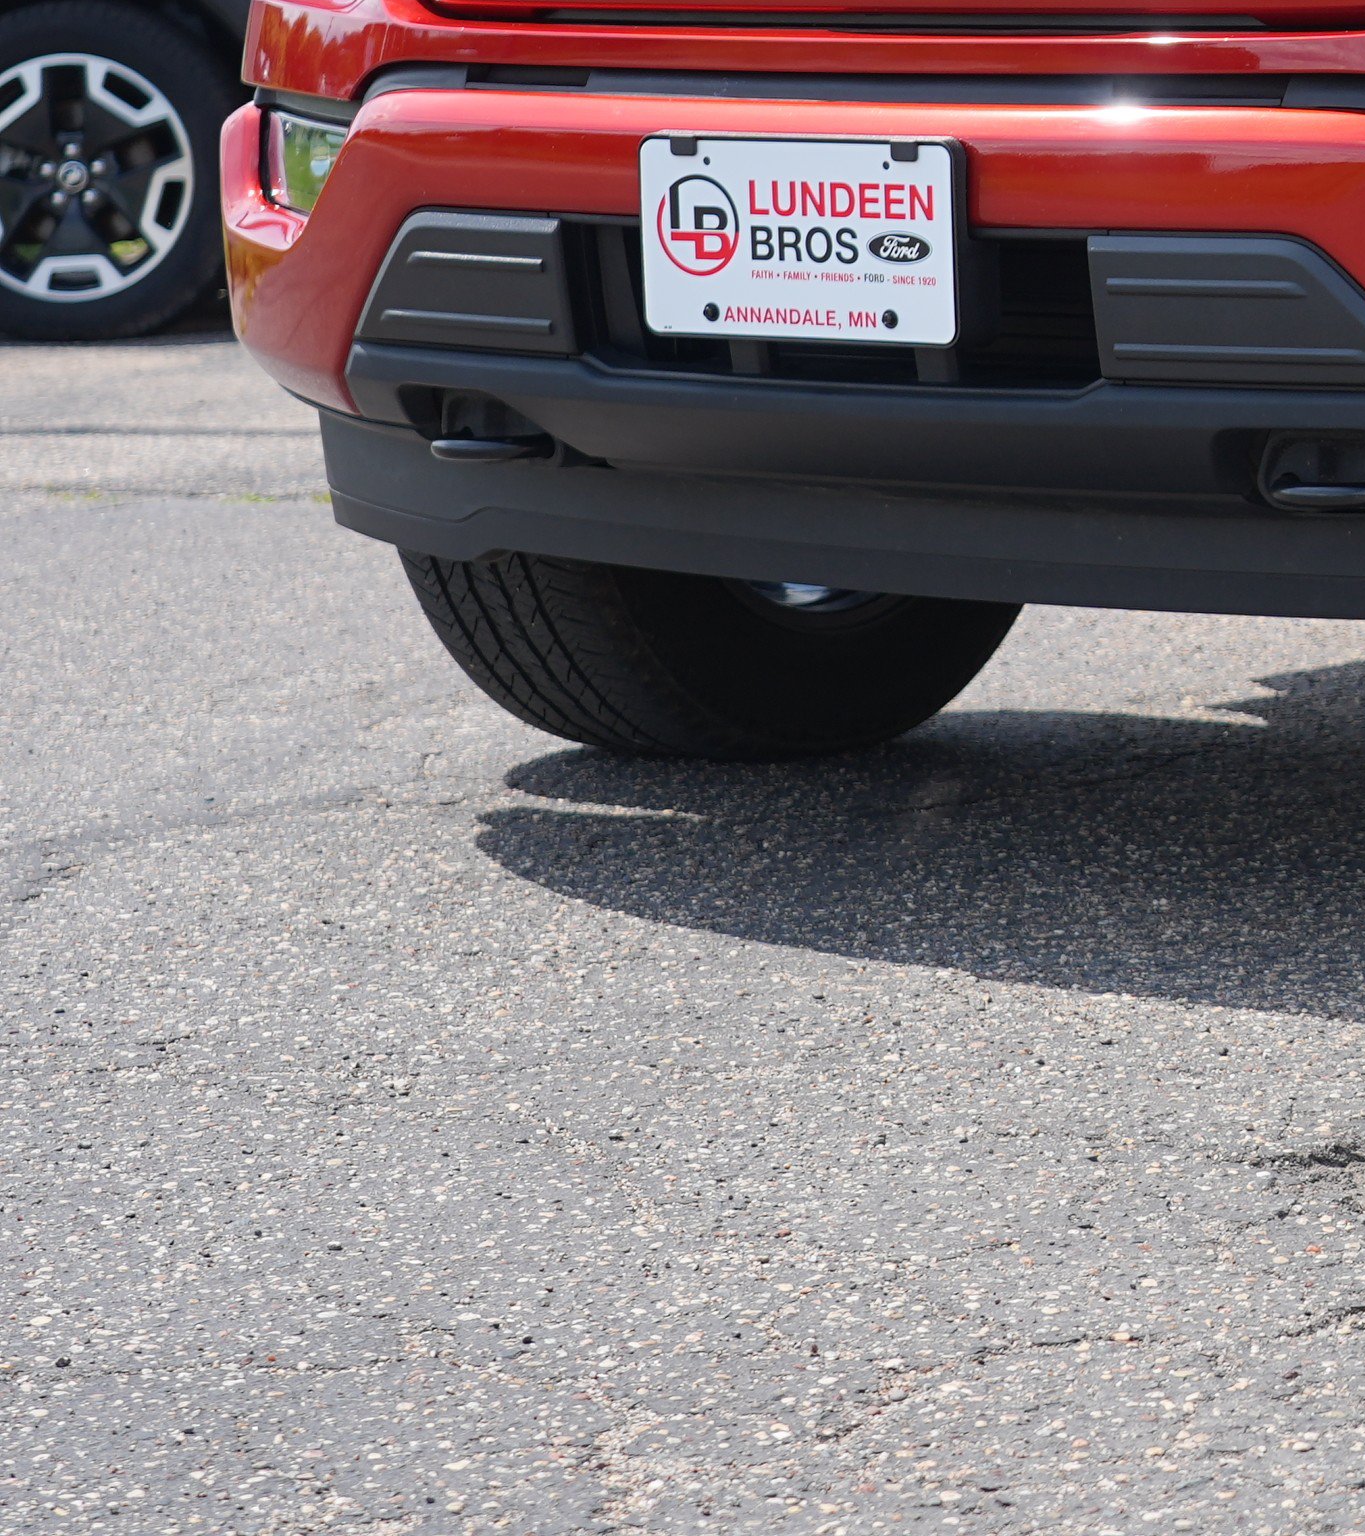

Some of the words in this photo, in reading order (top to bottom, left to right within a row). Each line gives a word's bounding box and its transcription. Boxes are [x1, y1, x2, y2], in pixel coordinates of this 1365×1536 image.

[748, 179, 934, 221] LUNDEEN
[750, 225, 859, 264] BROS
[878, 236, 920, 259] Ford
[751, 270, 774, 280] FAITH
[783, 271, 811, 281] FAMILY
[820, 272, 854, 283] FRIENDS
[863, 273, 885, 283] FORD
[892, 275, 915, 285] SINCE
[918, 276, 937, 286] 1920
[724, 306, 842, 330] ANNANDALE,
[848, 311, 877, 328] MN
